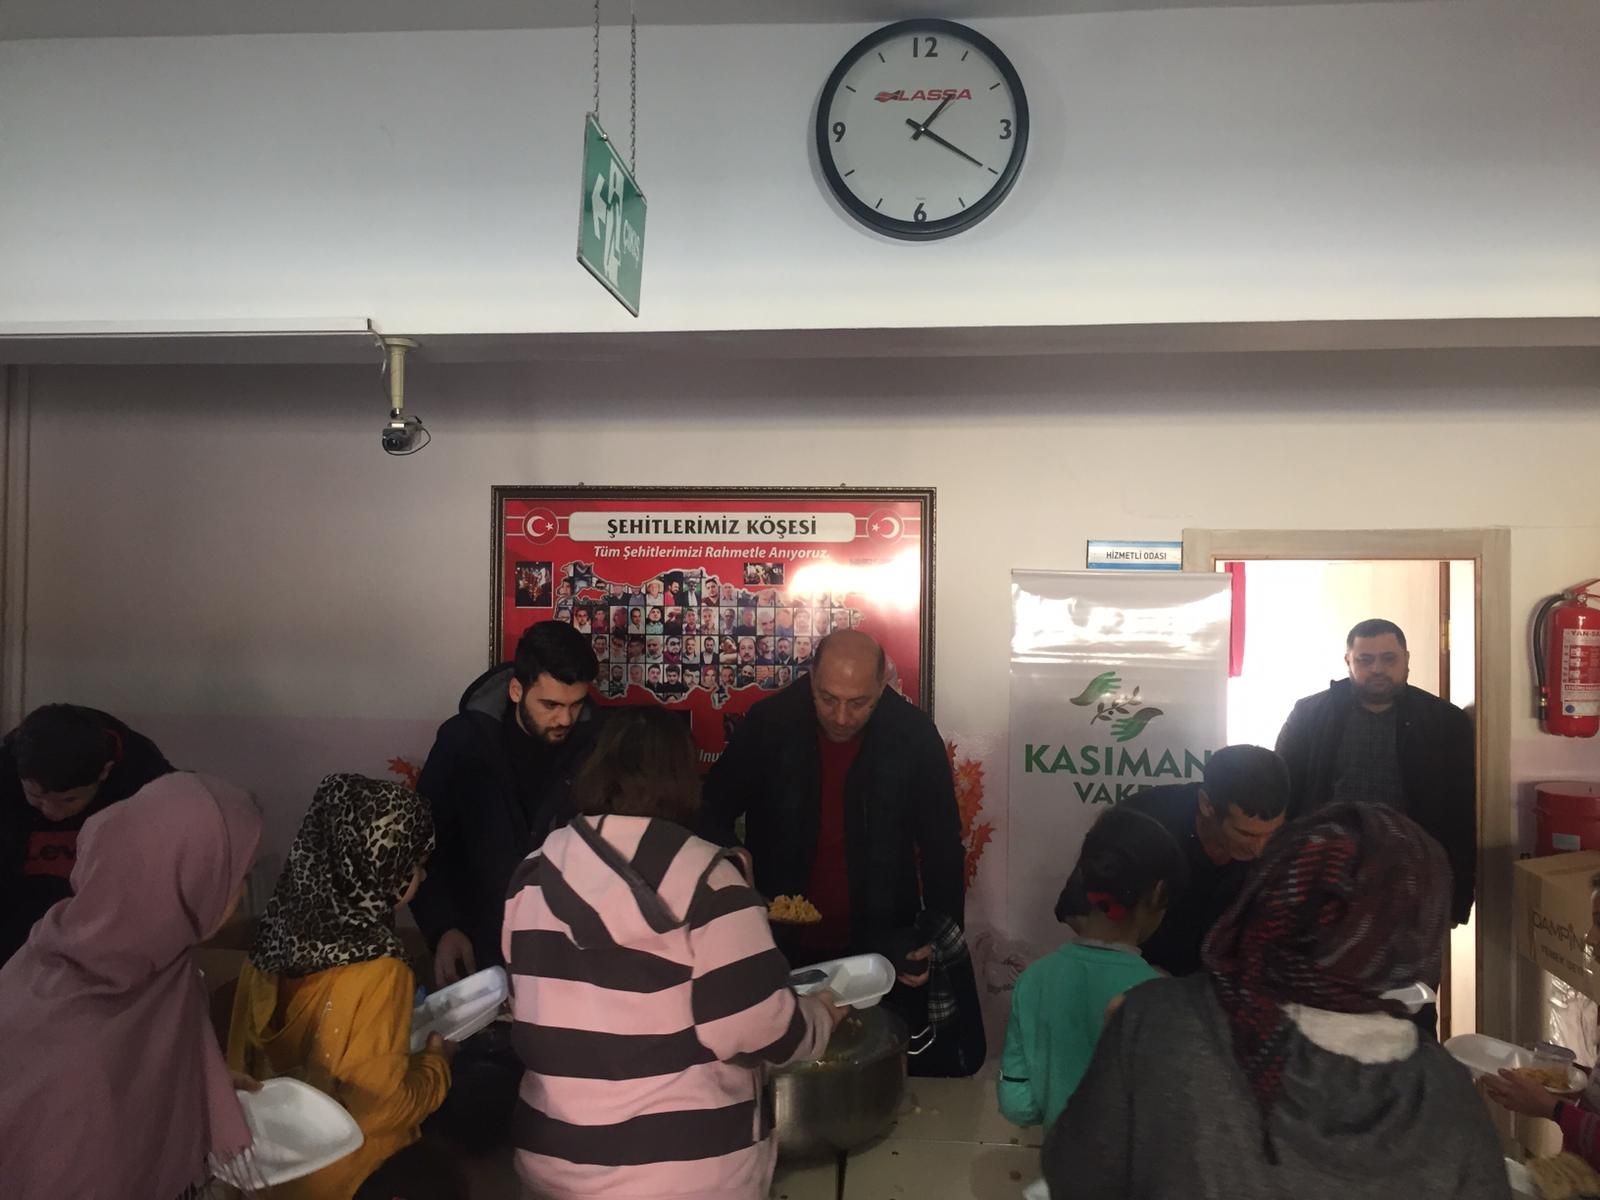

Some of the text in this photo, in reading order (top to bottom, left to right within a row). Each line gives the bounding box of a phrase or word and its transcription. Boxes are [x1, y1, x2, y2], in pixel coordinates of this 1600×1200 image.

[913, 37, 938, 58] 12
[897, 88, 973, 102] LASSA
[832, 121, 847, 142] 9
[999, 119, 1013, 140] 3
[913, 202, 928, 223] 6
[607, 515, 817, 539] ŞEHİTLERİMİZ KÖŞESİ
[594, 546, 621, 558] Tüm
[623, 545, 702, 559] Şehitlerimizi
[704, 546, 766, 558] Rahmetle
[1106, 550, 1167, 561] HİZMETLİ ODASI
[1024, 743, 1213, 779] KASIMAN
